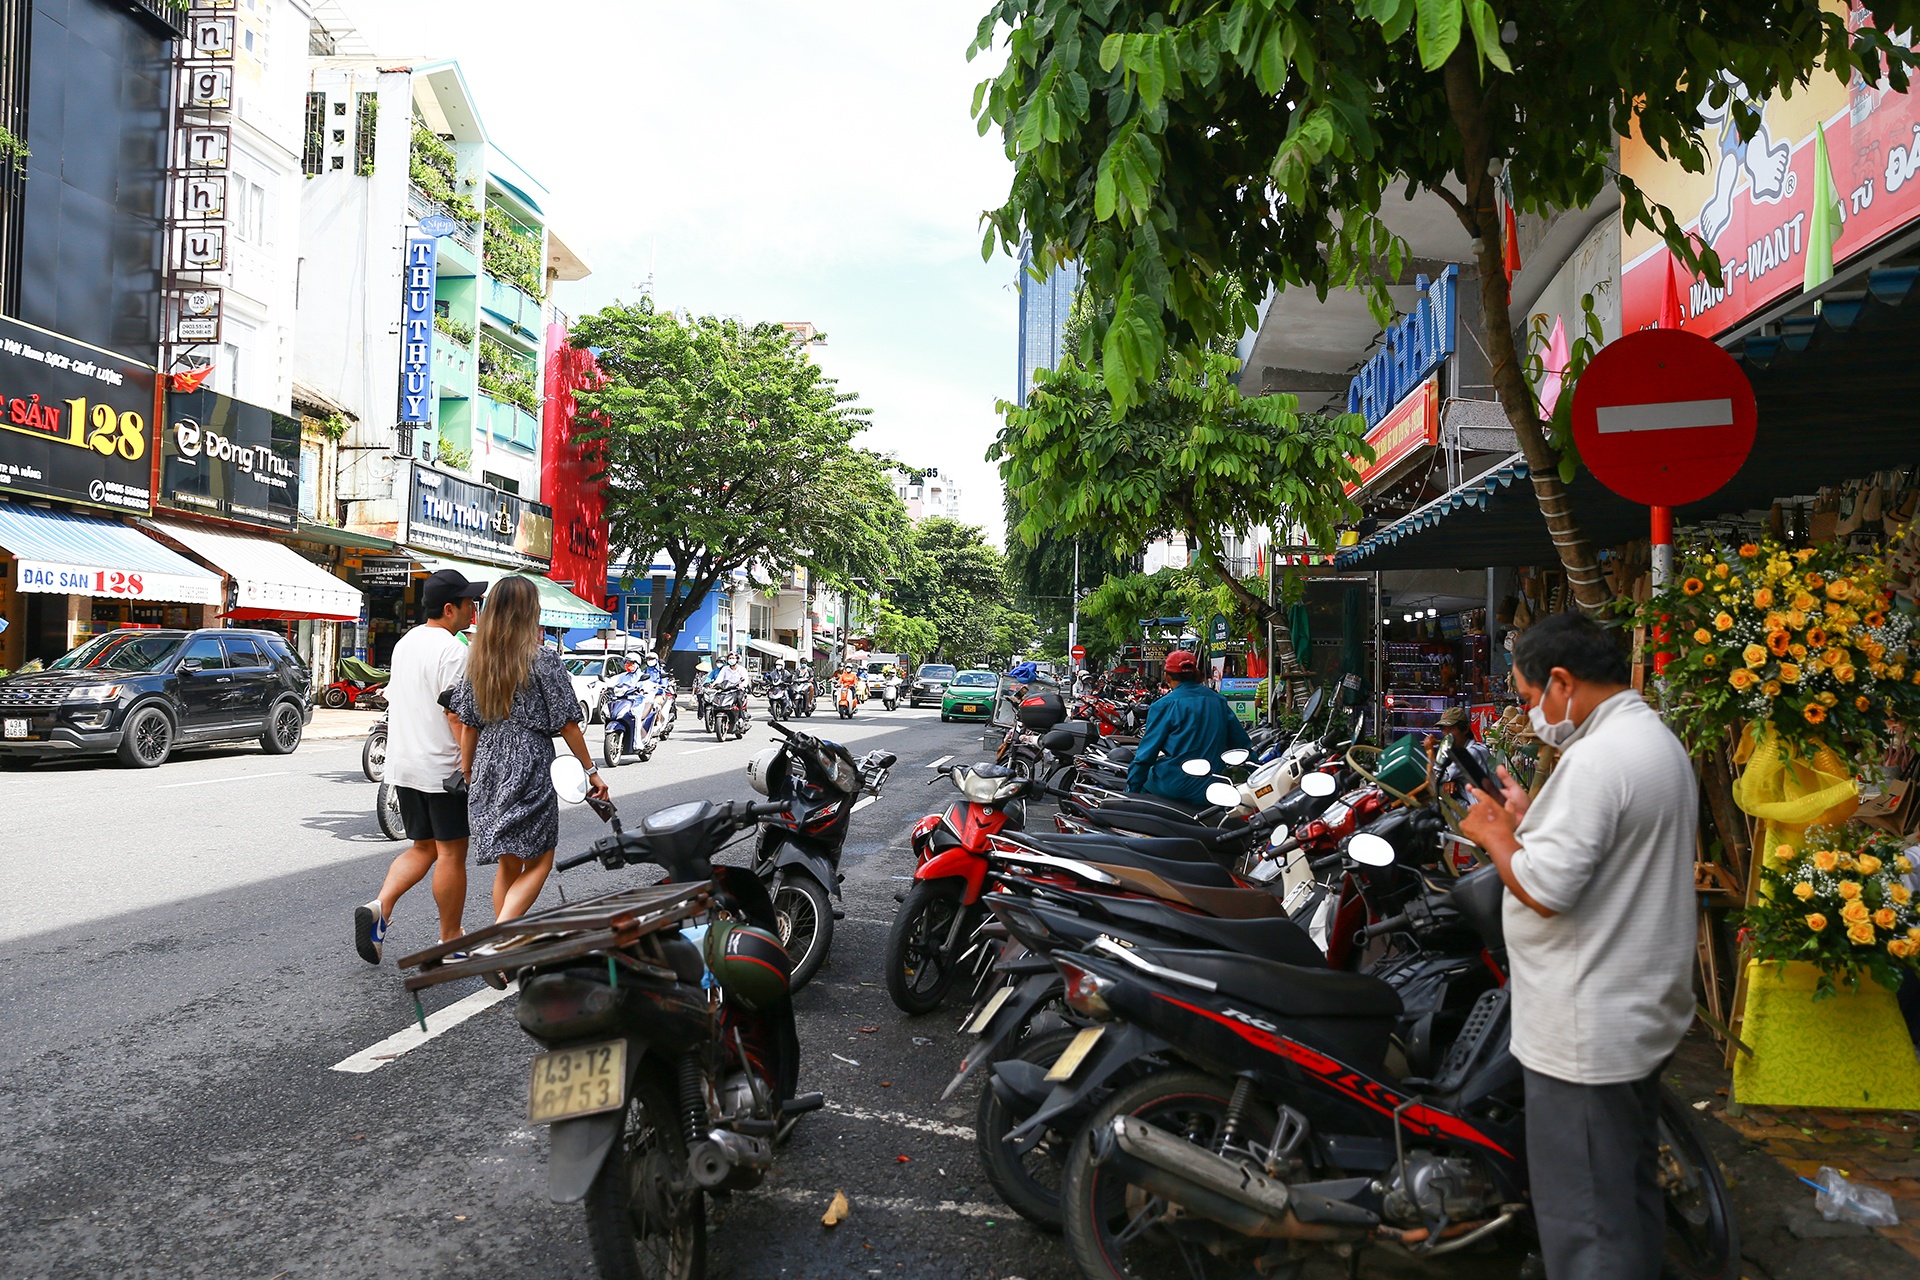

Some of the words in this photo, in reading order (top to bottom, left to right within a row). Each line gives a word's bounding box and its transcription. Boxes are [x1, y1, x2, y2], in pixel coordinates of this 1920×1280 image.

[10, 393, 60, 432] SẢN
[63, 396, 145, 460] 128
[424, 495, 453, 522] THU
[454, 501, 489, 532] THỦY
[24, 566, 54, 588] ĐẶC
[59, 567, 89, 588] SẢN
[93, 571, 144, 595] 128
[545, 1046, 612, 1085] 43-T2
